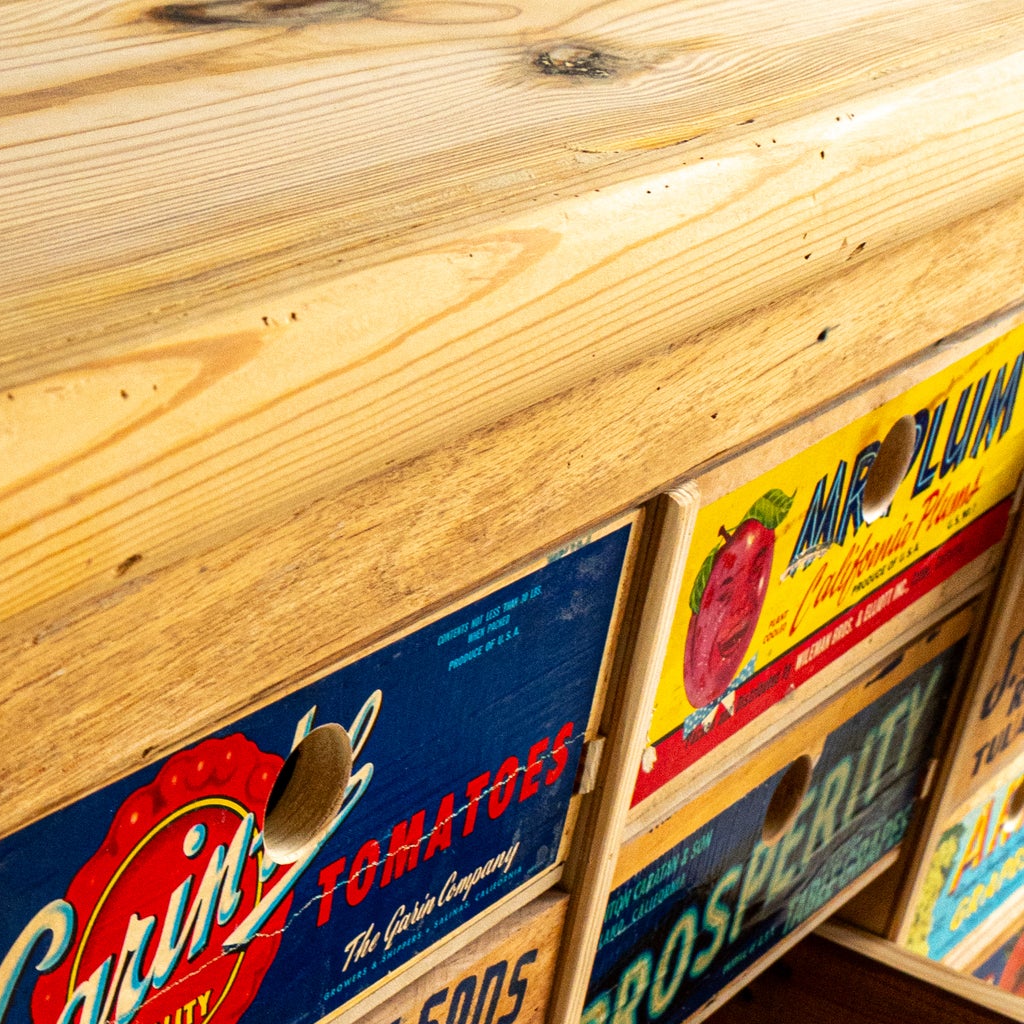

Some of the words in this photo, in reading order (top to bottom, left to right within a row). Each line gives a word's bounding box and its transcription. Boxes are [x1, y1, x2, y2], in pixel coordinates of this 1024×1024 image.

[437, 622, 469, 646] CONTENTS
[470, 614, 483, 630] NOT
[485, 606, 501, 622] LESS
[467, 627, 485, 643] WHEN
[486, 614, 511, 634] PACKED
[788, 512, 913, 637] California
[448, 645, 483, 671] PRODUCE
[485, 638, 496, 651] OF
[316, 721, 575, 928] TOMATOES
[323, 968, 368, 1001] GROWERS
[372, 961, 378, 971] &
[381, 932, 422, 963] SHIPPERS
[475, 866, 523, 902] CALIFORNIA
[342, 923, 381, 972] The
[384, 893, 436, 950] Garin
[437, 841, 520, 907] Company
